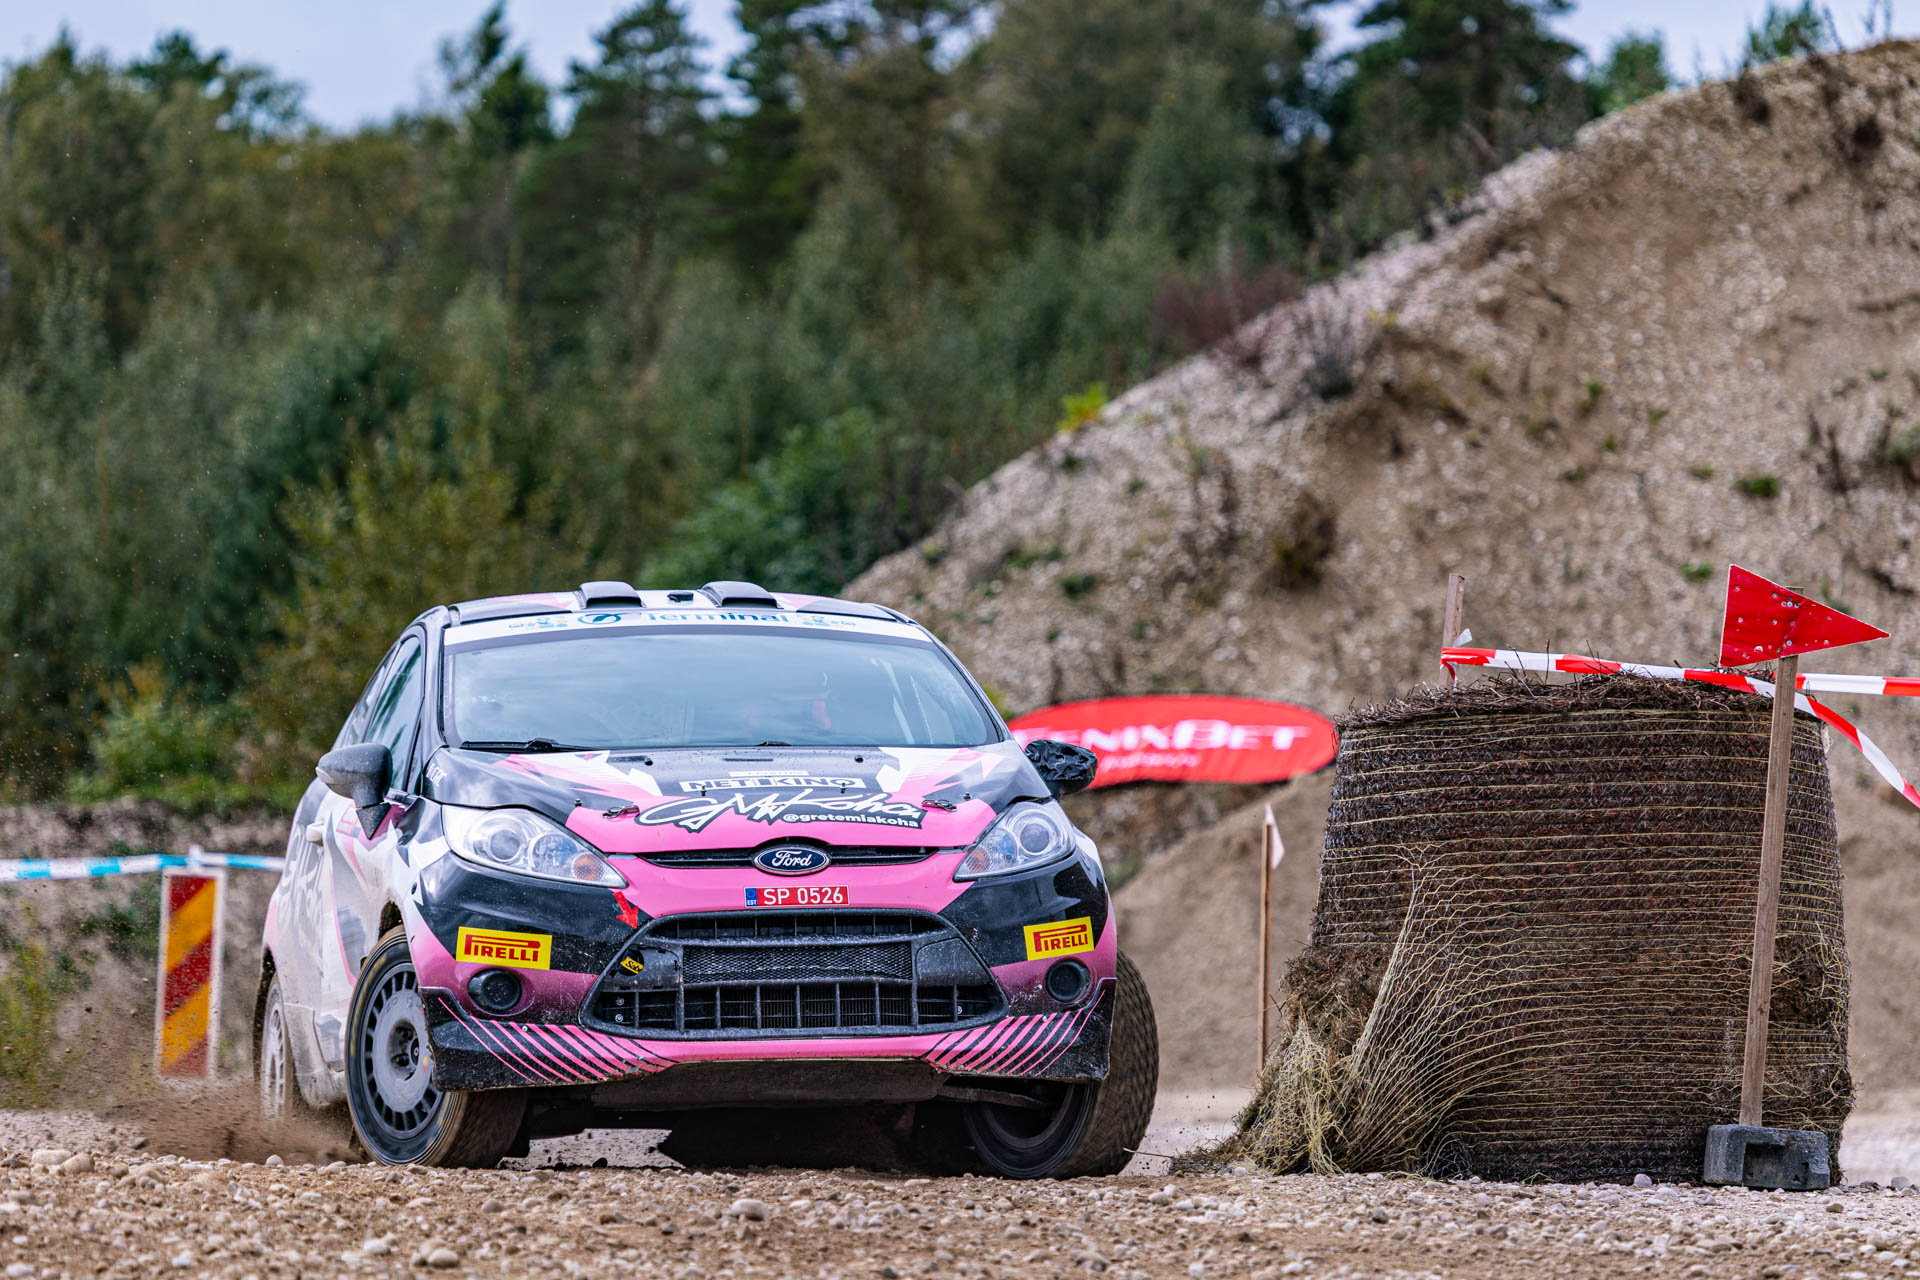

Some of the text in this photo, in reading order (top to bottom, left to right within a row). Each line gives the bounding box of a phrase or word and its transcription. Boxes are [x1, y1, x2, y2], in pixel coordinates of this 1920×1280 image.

[782, 813, 919, 828] @gretemiakoha
[771, 850, 812, 867] Ford
[763, 887, 844, 905] SP 0526
[1033, 924, 1088, 952] PIRELLI
[464, 934, 541, 962] PIRELLI
